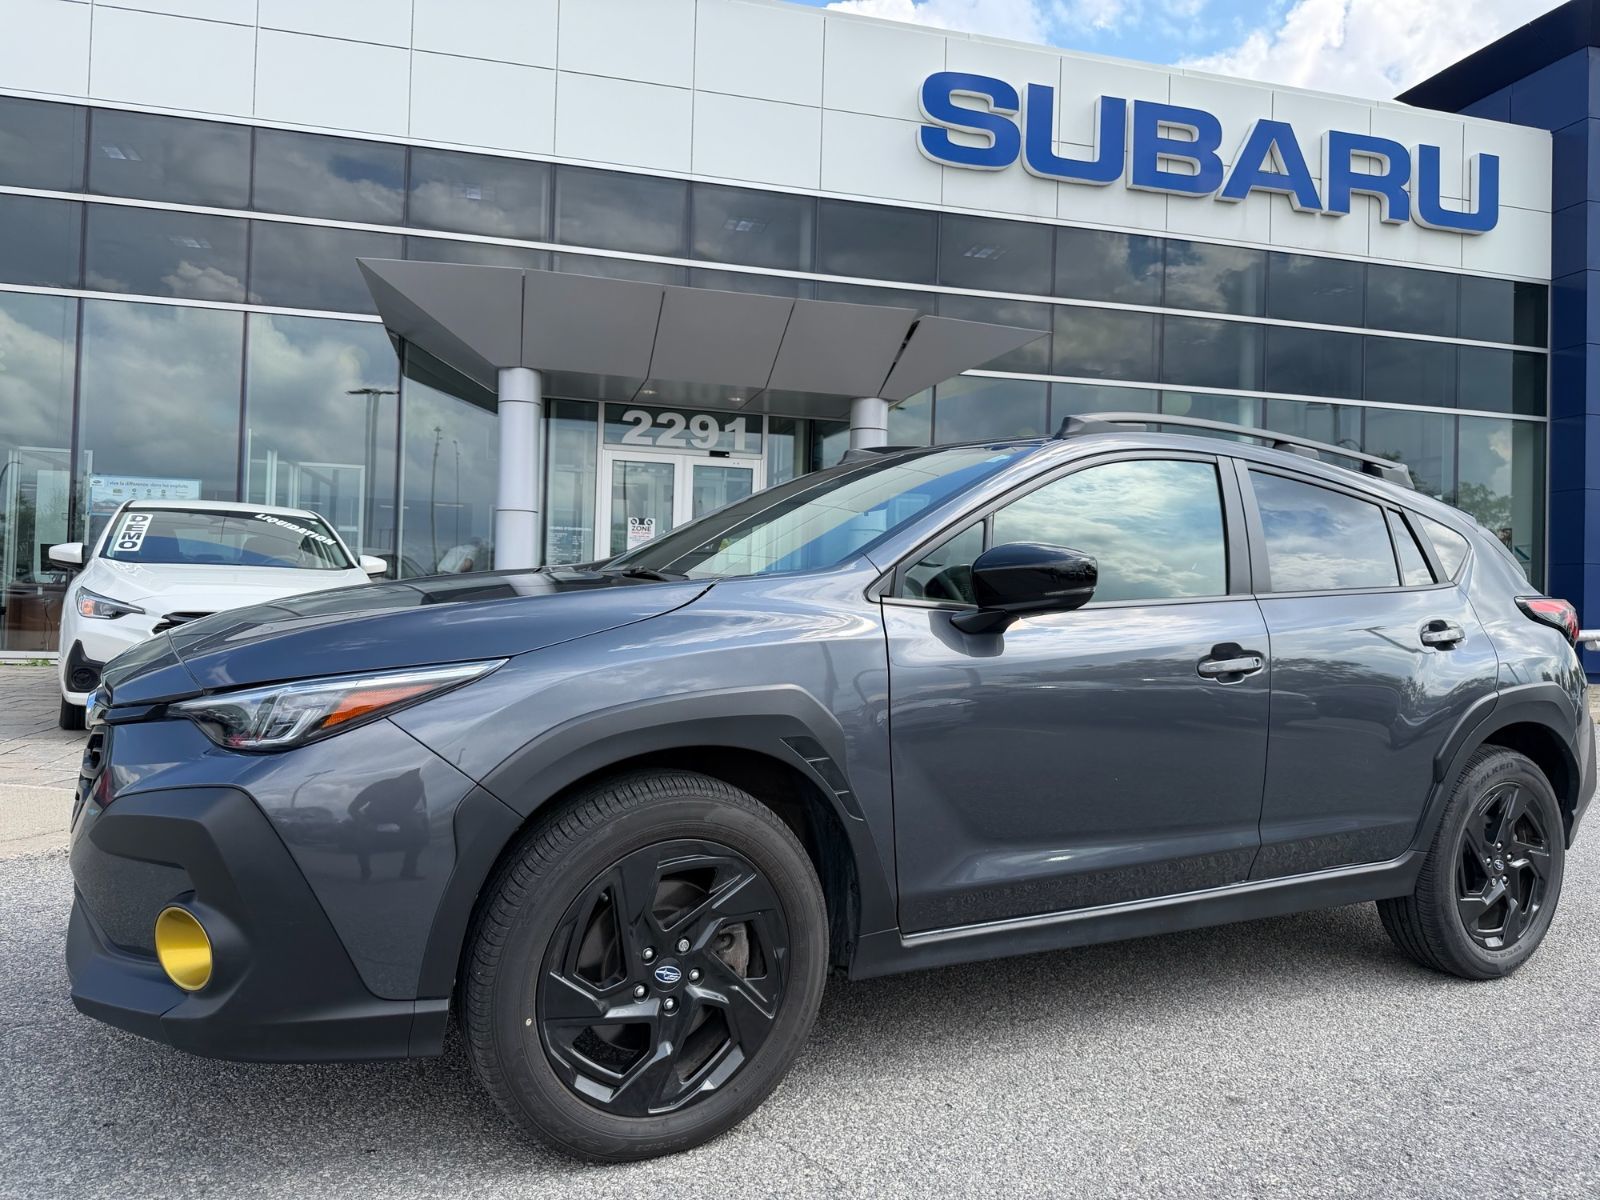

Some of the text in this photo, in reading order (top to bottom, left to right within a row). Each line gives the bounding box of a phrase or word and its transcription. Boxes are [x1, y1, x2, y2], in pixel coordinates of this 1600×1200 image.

[918, 71, 1499, 235] SUBARU
[621, 409, 747, 450] 2291
[118, 514, 149, 550] DEMO
[254, 513, 337, 546] LIQUIDATION
